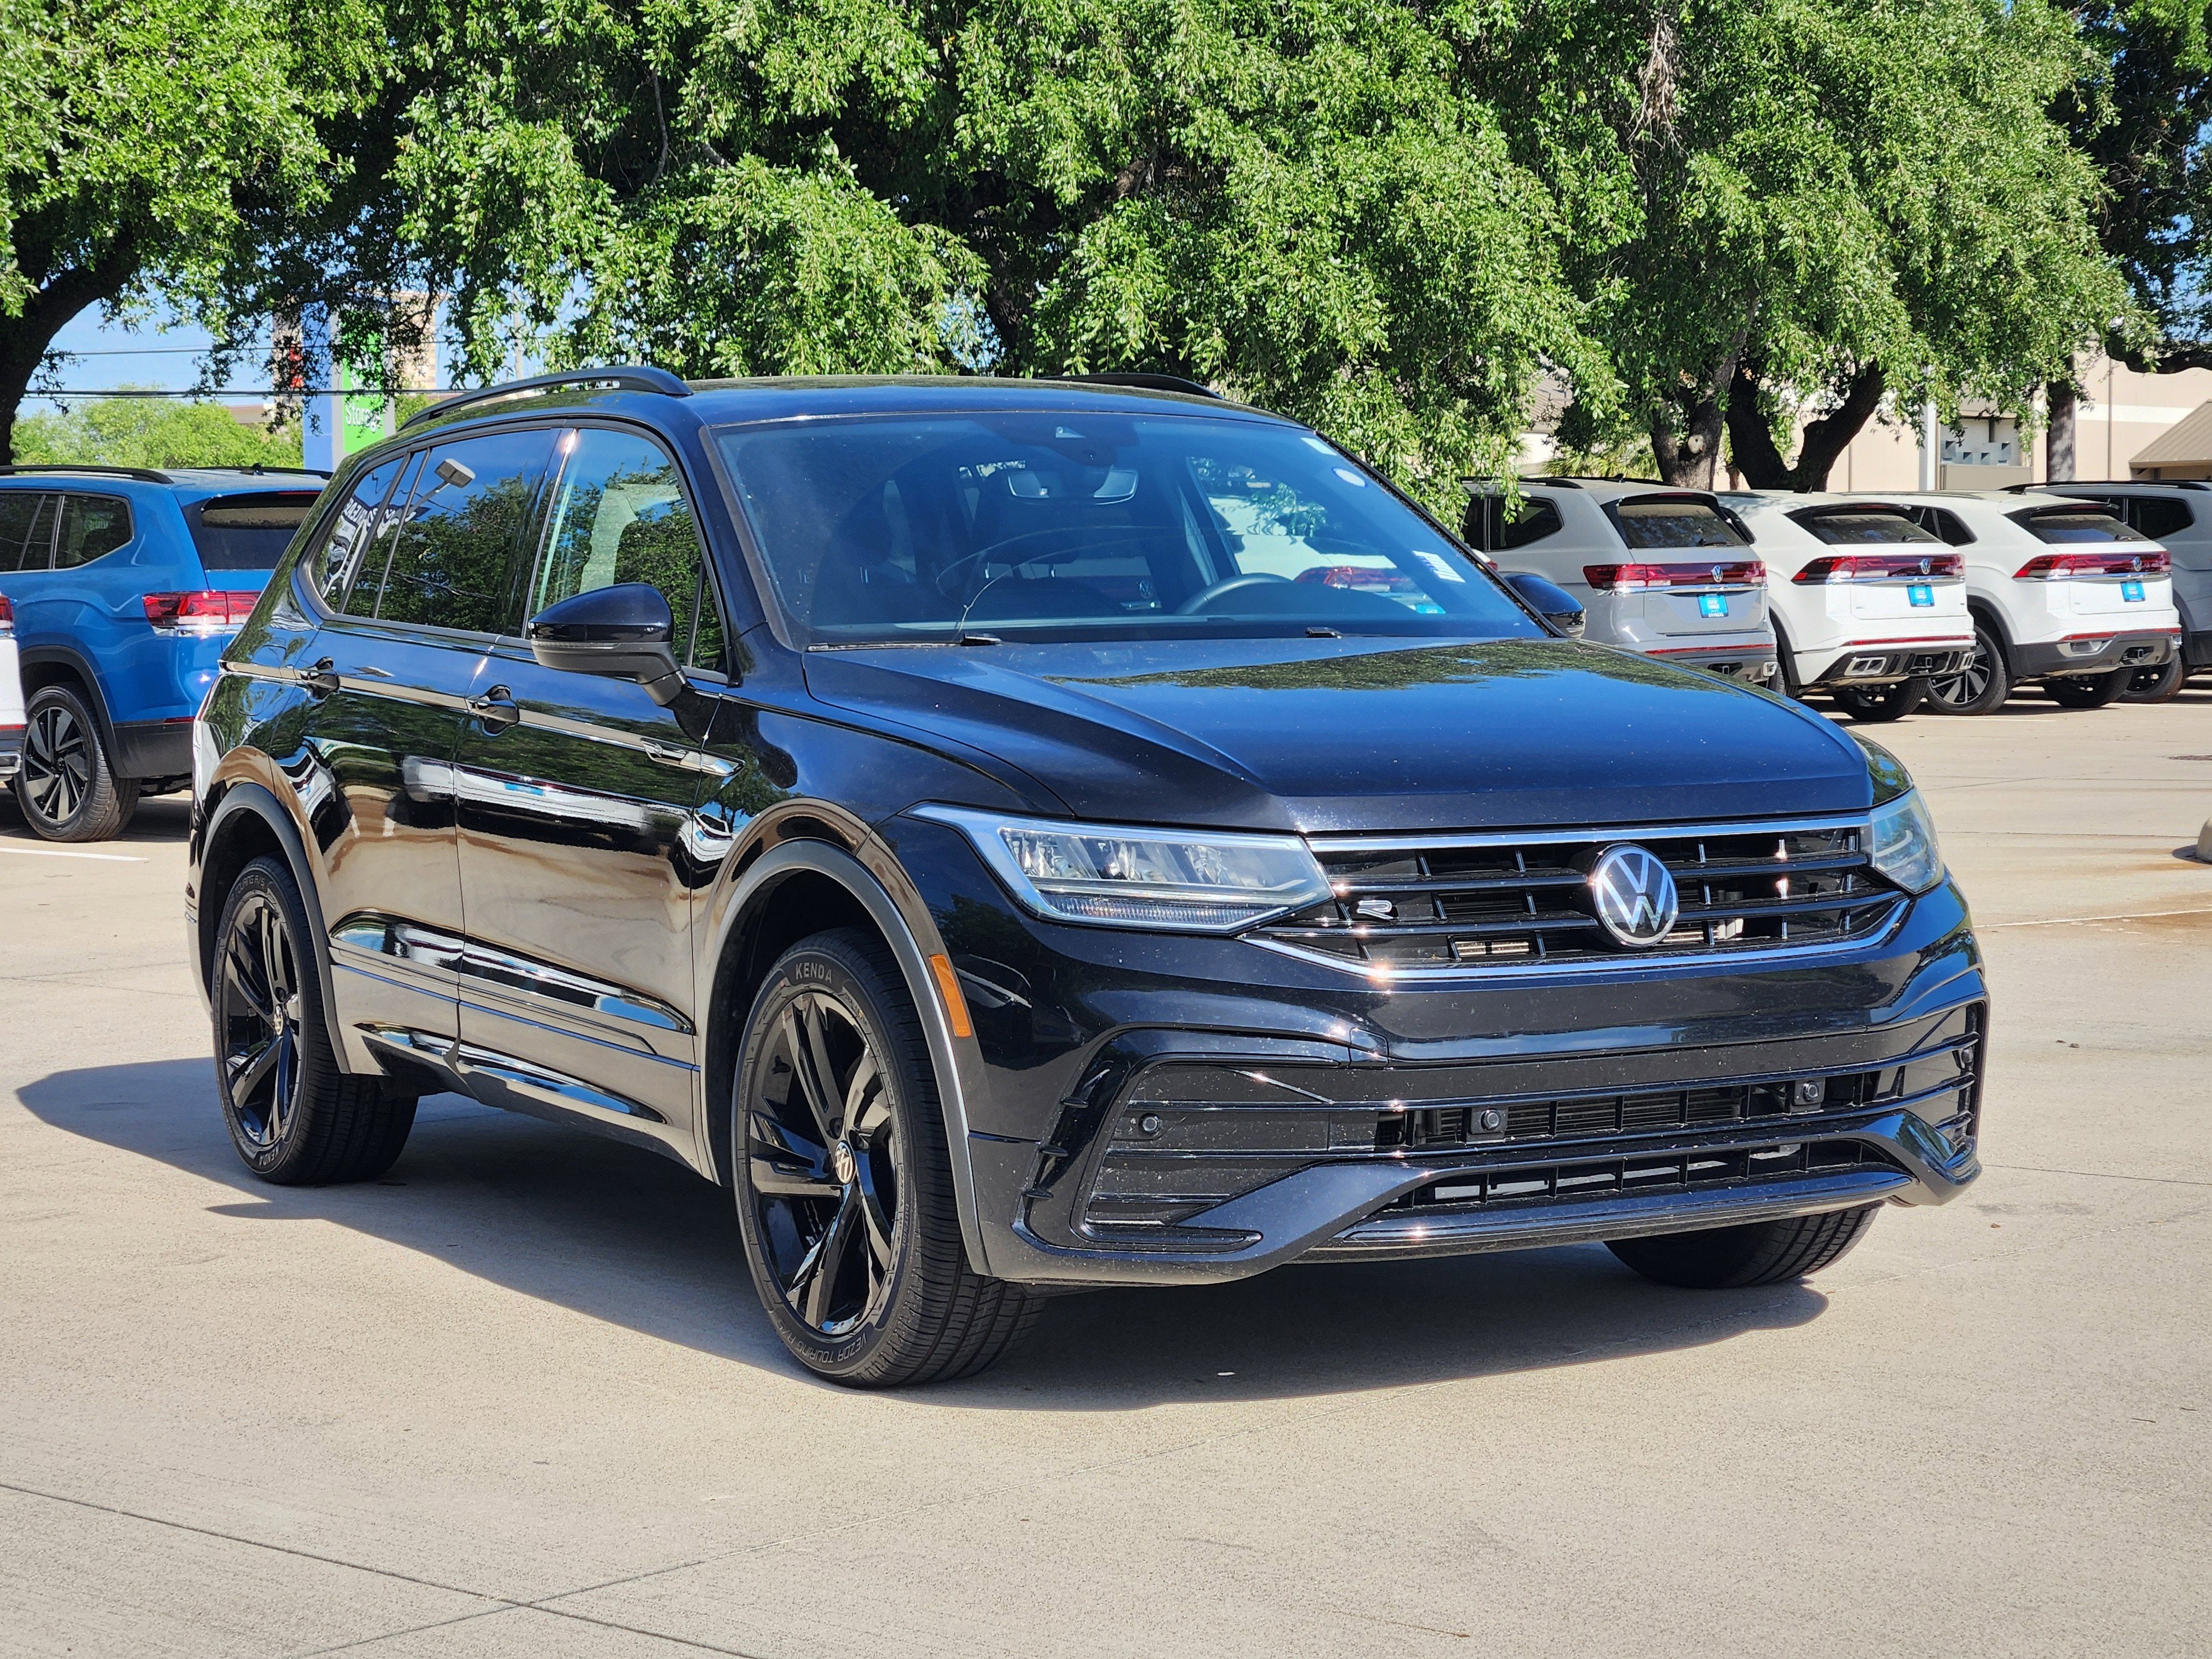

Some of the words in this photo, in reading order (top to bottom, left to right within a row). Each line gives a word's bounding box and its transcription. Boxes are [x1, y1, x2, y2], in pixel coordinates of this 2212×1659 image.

[1599, 851, 1672, 937] VW
[795, 962, 832, 984] KENDA
[795, 1340, 834, 1363] TOURING
[837, 1332, 867, 1362] VEZDA
